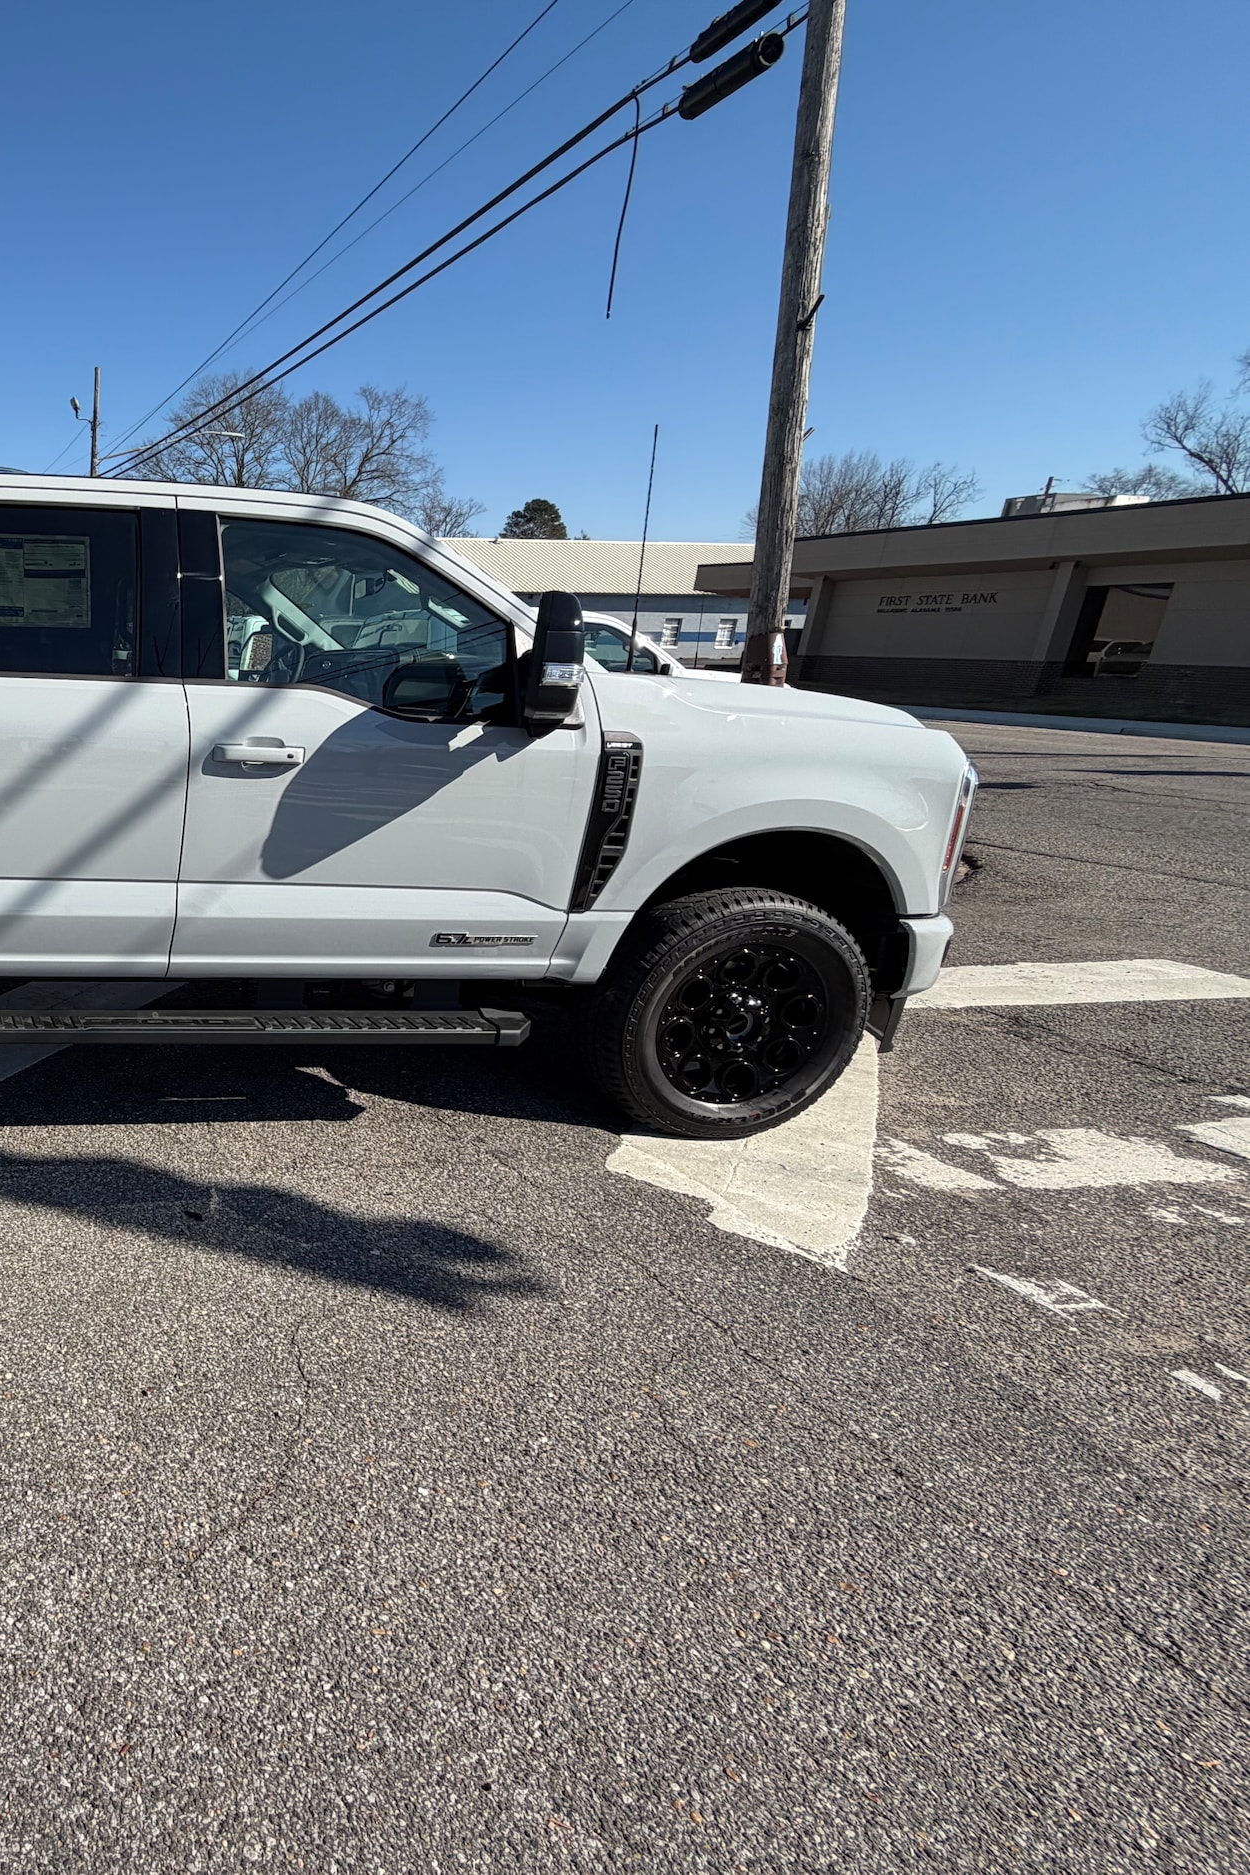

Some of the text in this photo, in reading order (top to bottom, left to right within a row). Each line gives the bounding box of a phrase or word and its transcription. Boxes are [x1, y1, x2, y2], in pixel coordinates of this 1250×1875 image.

[878, 592, 998, 606] FIRST STATE BANK
[435, 933, 472, 945] 6.7L
